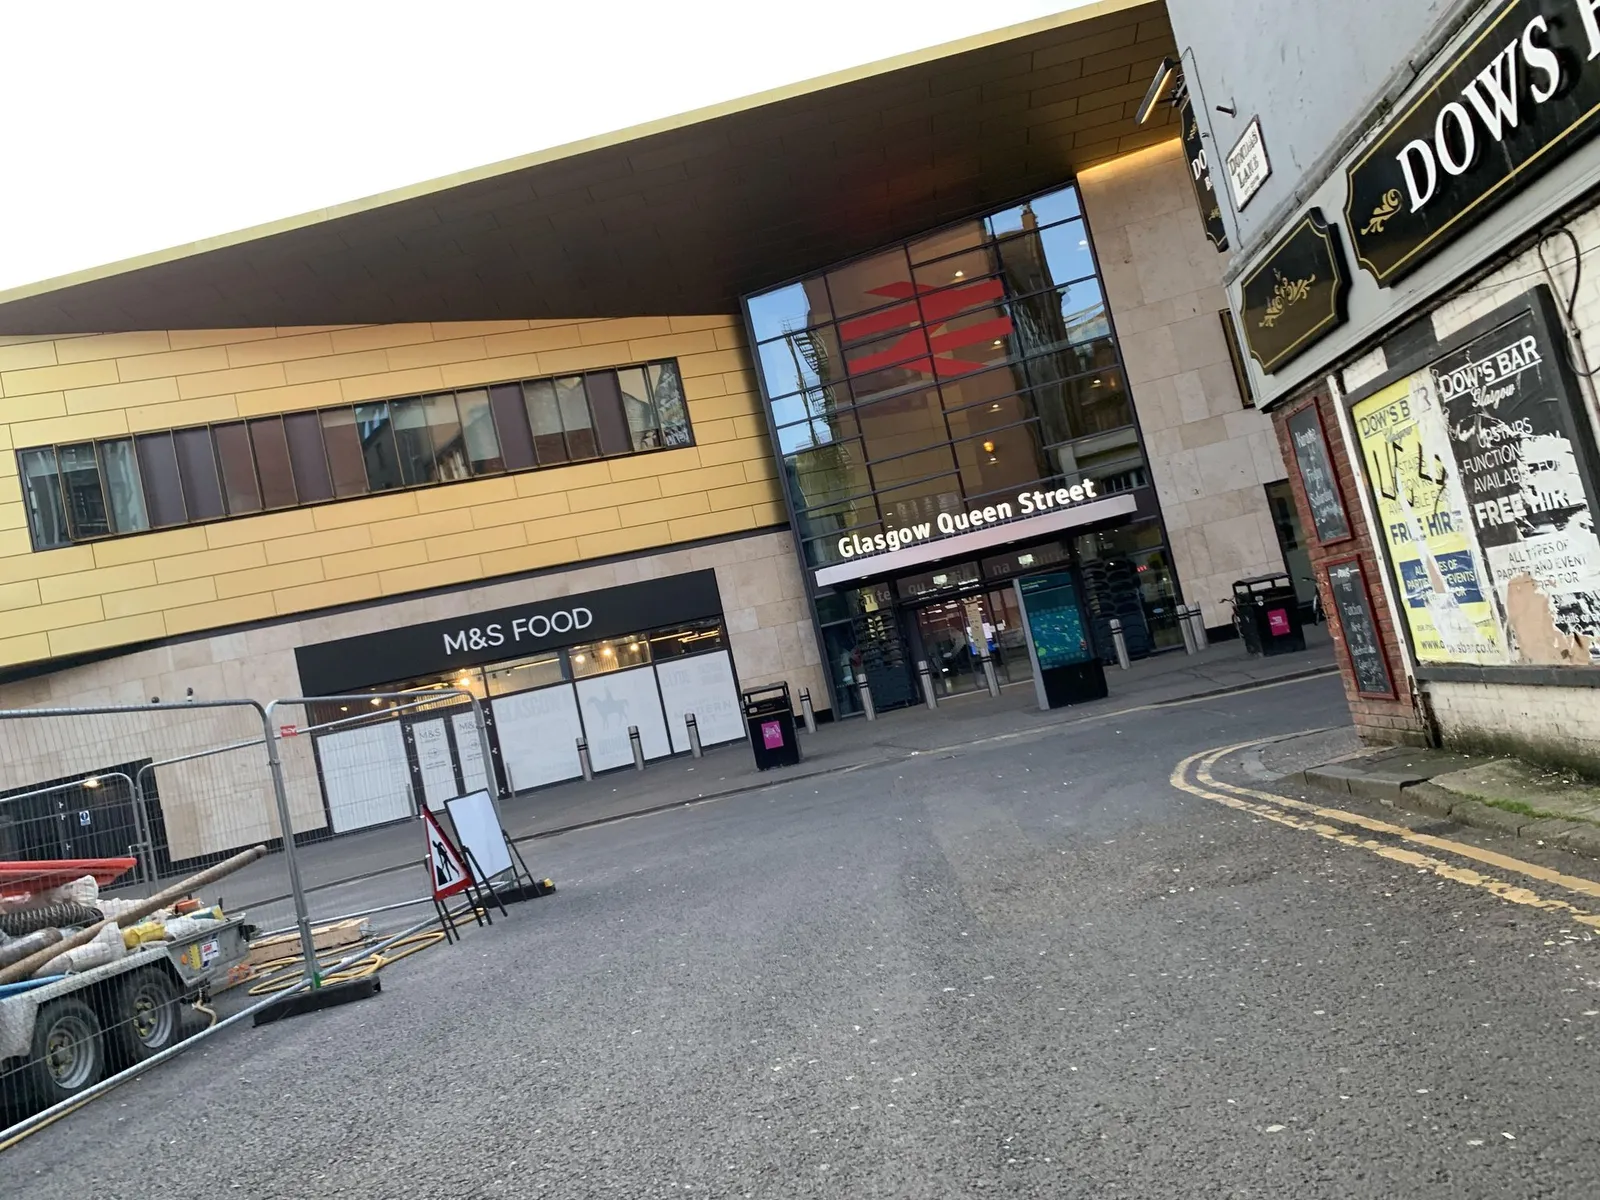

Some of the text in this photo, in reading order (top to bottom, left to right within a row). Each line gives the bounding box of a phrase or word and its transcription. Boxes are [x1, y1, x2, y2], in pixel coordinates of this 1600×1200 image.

[1395, 14, 1560, 214] DOWS
[1191, 149, 1207, 181] DO
[1438, 335, 1541, 398] DOW'S BAR
[1359, 405, 1399, 437] DOW'S
[1463, 442, 1522, 475] FUNCTION
[837, 477, 1098, 558] Glasgow Queen Street
[1473, 493, 1528, 529] FREE
[1508, 551, 1525, 563] ALL
[1447, 571, 1475, 584] EVENTS
[443, 607, 593, 656] M&S FOOD
[418, 727, 442, 741] M&S
